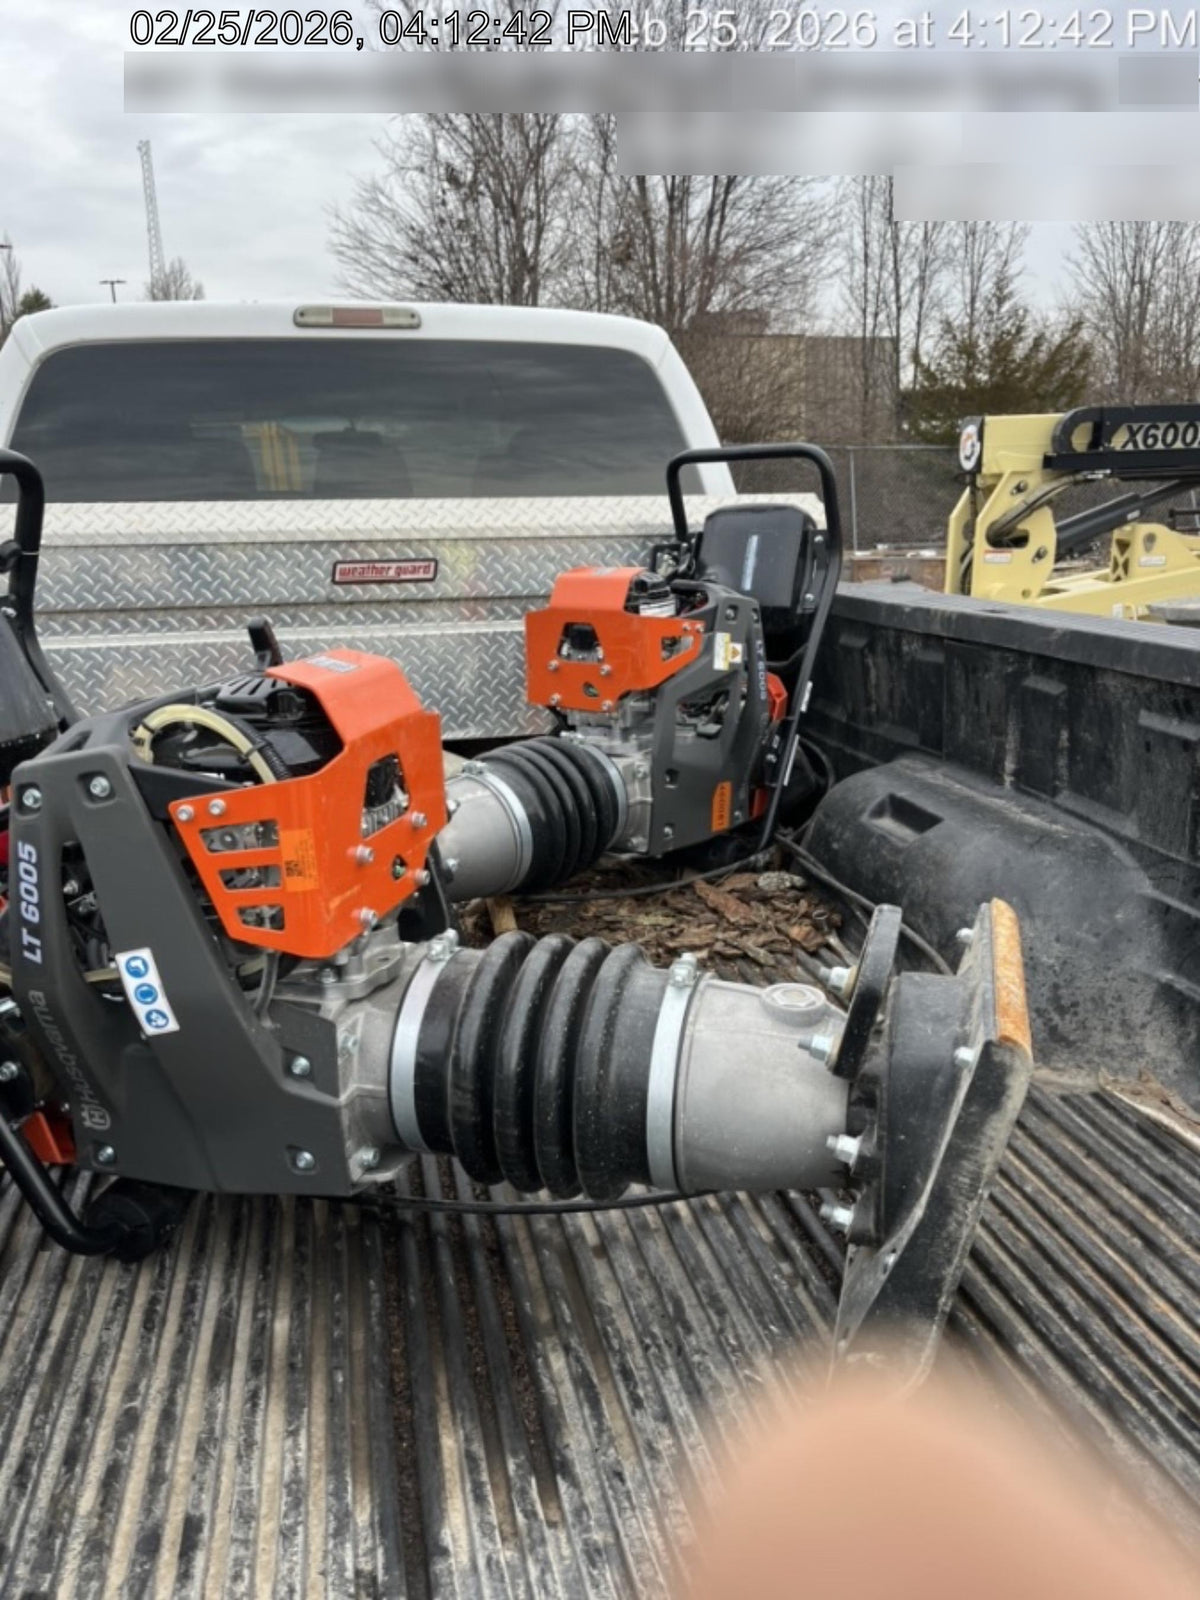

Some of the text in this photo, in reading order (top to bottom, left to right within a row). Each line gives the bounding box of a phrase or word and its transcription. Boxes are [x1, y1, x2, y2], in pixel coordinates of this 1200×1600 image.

[339, 563, 431, 577] weather guard
[18, 841, 43, 964] LT 6005
[28, 989, 99, 1104] Husqvarna
